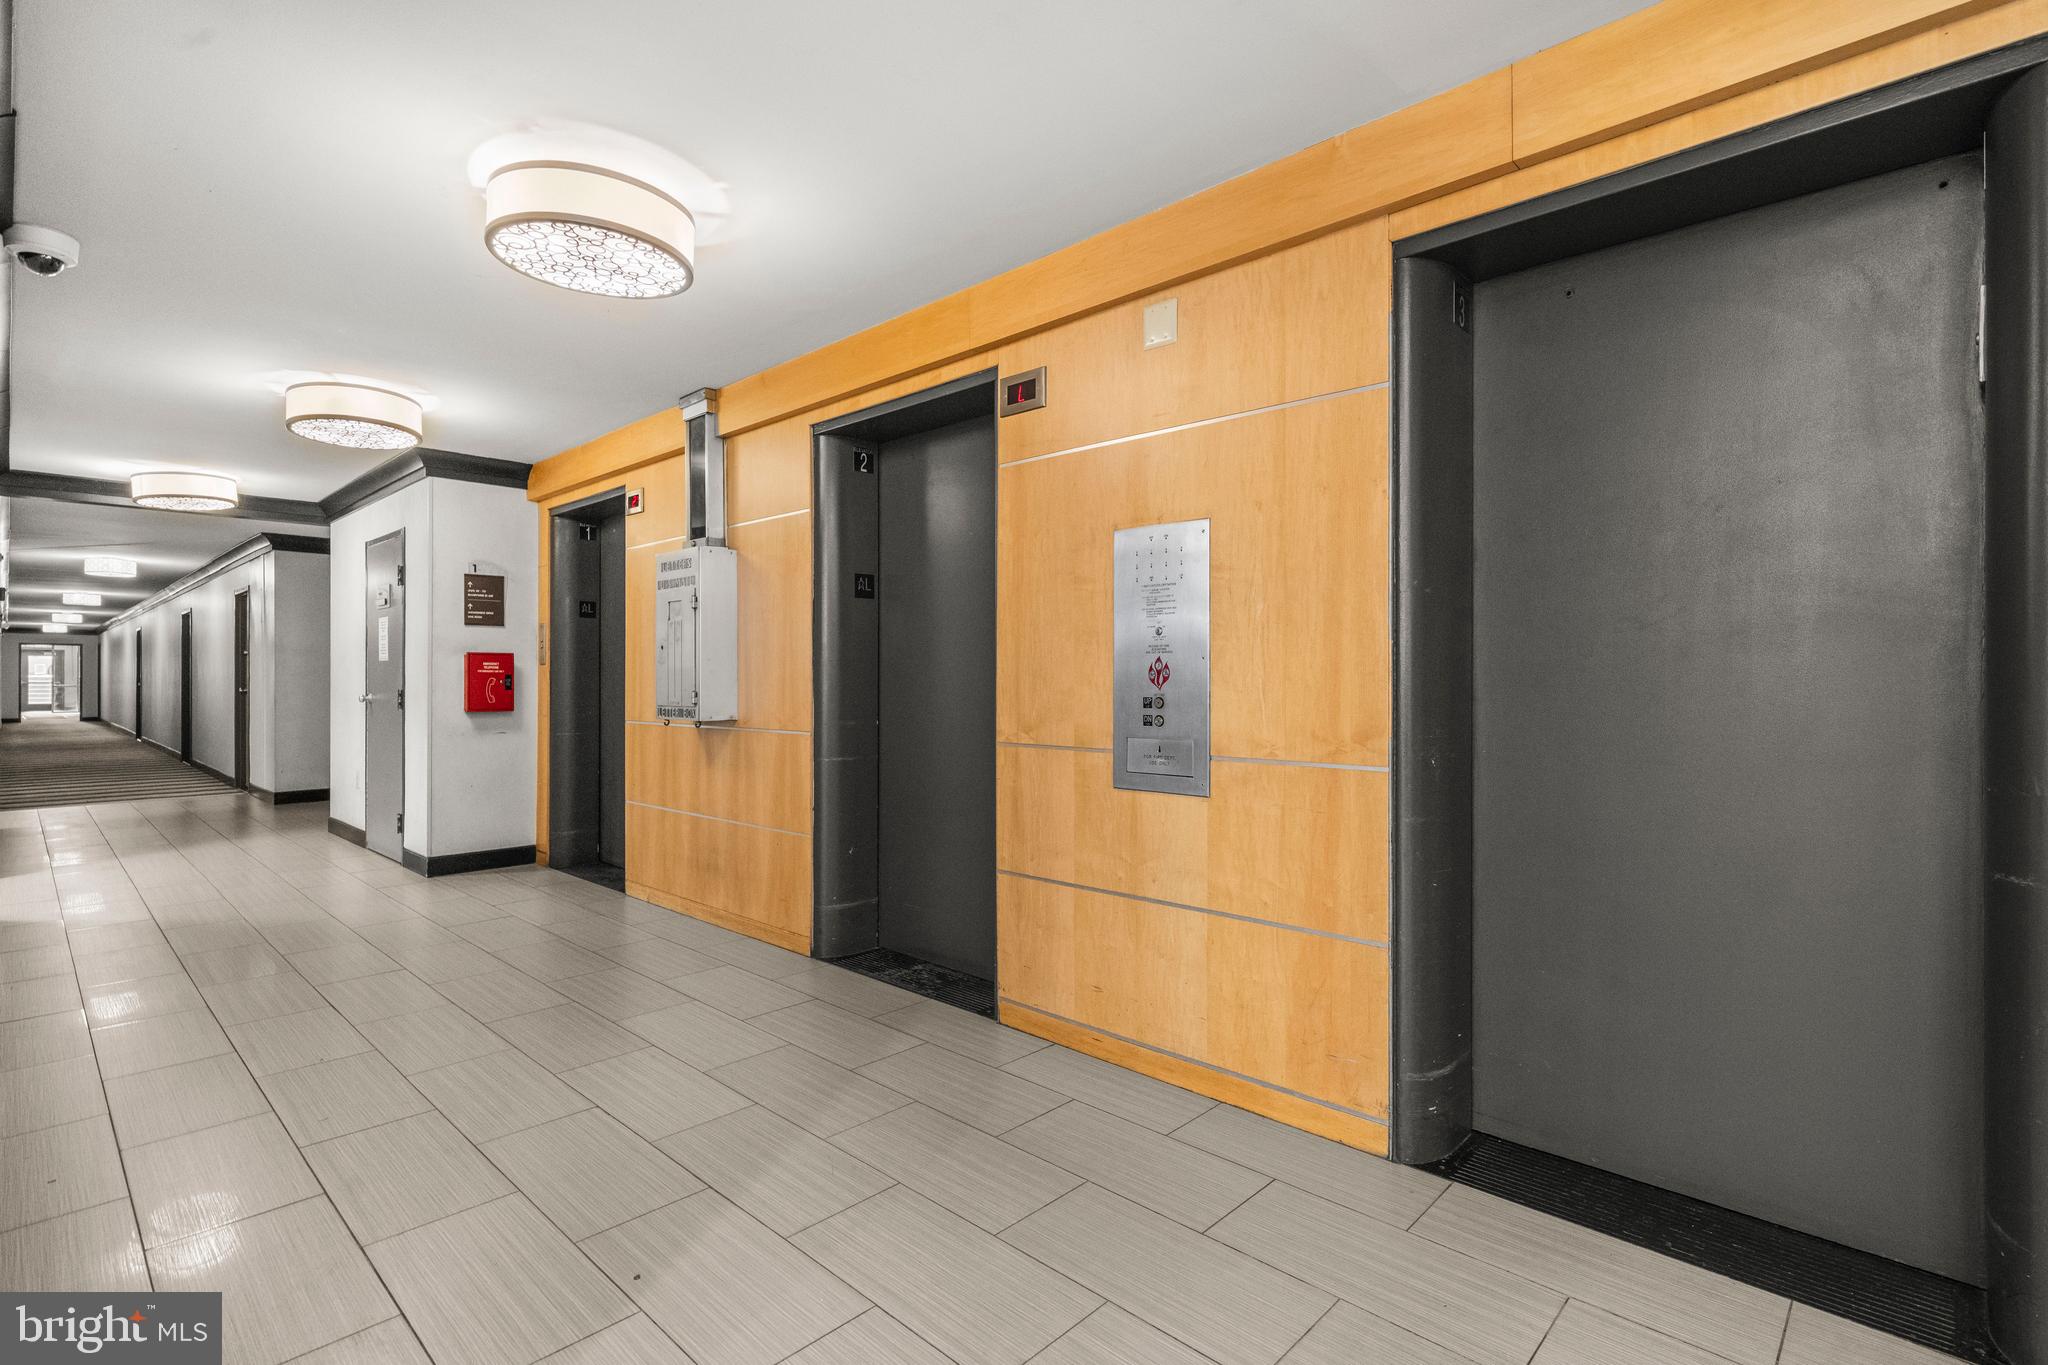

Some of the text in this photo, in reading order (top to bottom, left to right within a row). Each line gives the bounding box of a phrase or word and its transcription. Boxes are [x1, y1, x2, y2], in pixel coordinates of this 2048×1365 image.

[1458, 295, 1466, 328] 3
[1017, 383, 1025, 403] L
[860, 452, 868, 473] 2
[585, 527, 591, 541] 1
[472, 563, 477, 573] 1
